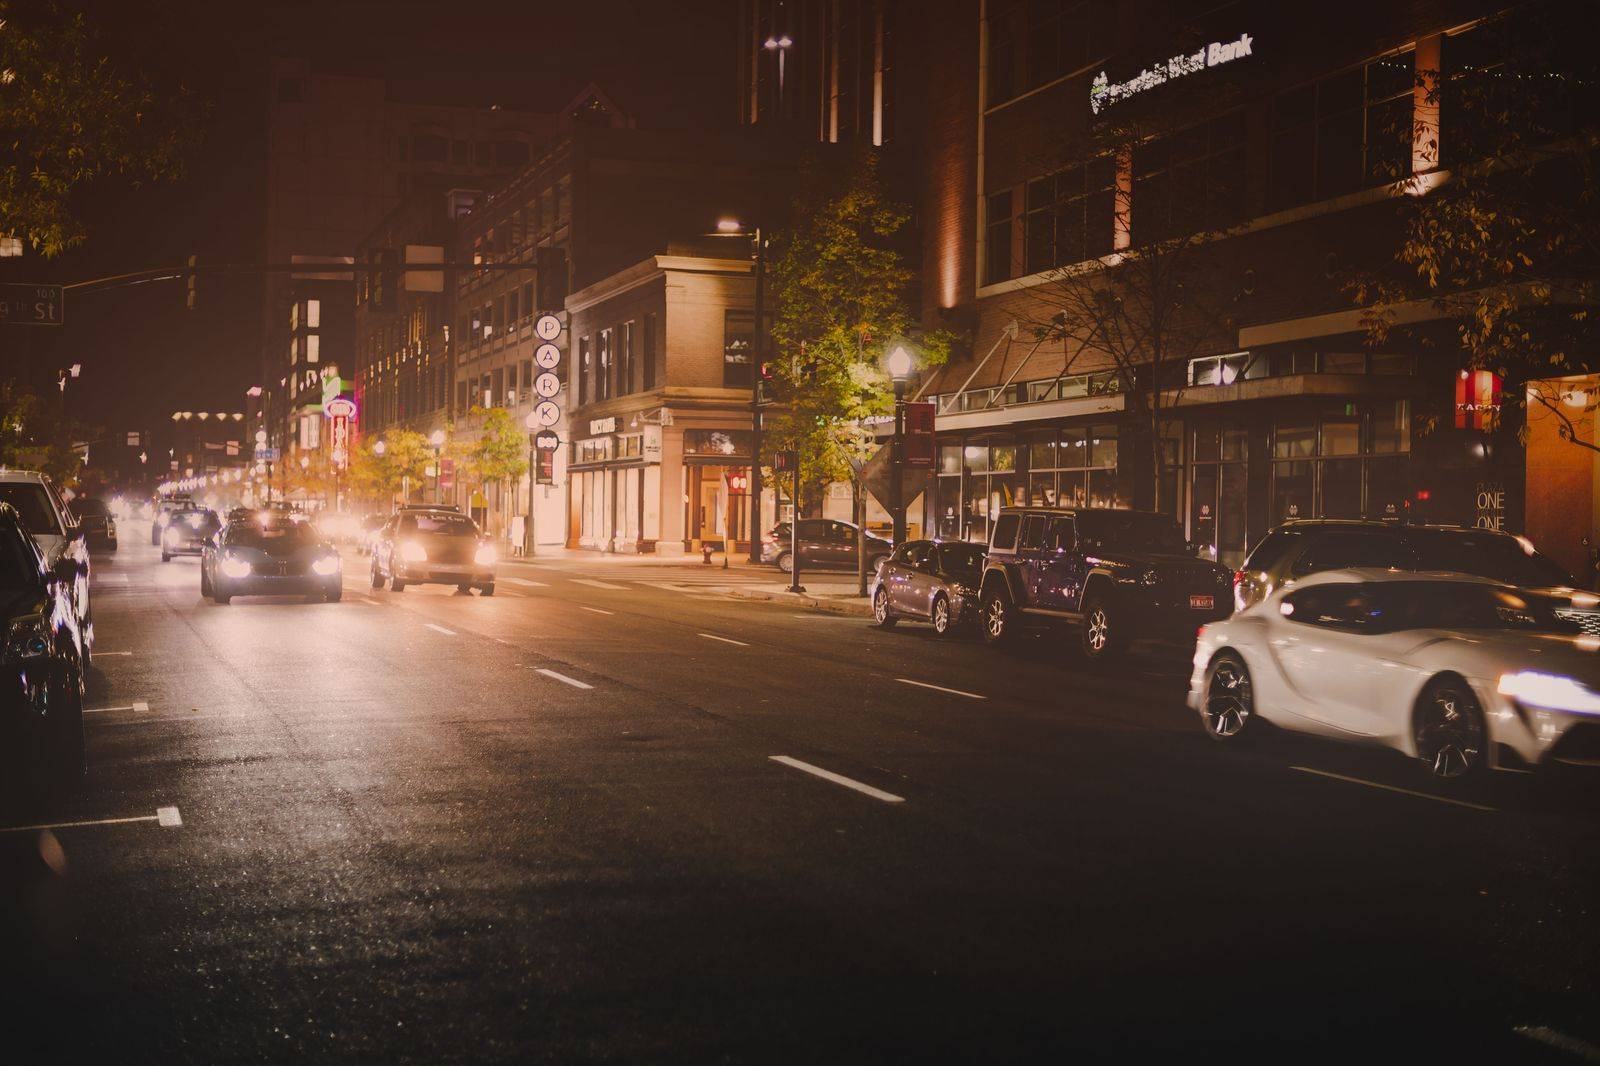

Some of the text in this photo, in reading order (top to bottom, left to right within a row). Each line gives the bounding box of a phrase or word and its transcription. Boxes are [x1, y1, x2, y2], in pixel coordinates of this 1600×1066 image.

[1208, 33, 1254, 67] Bank
[35, 302, 55, 320] St
[540, 321, 556, 421] PARK
[1477, 492, 1505, 509] ONE
[1477, 516, 1505, 529] ONE
